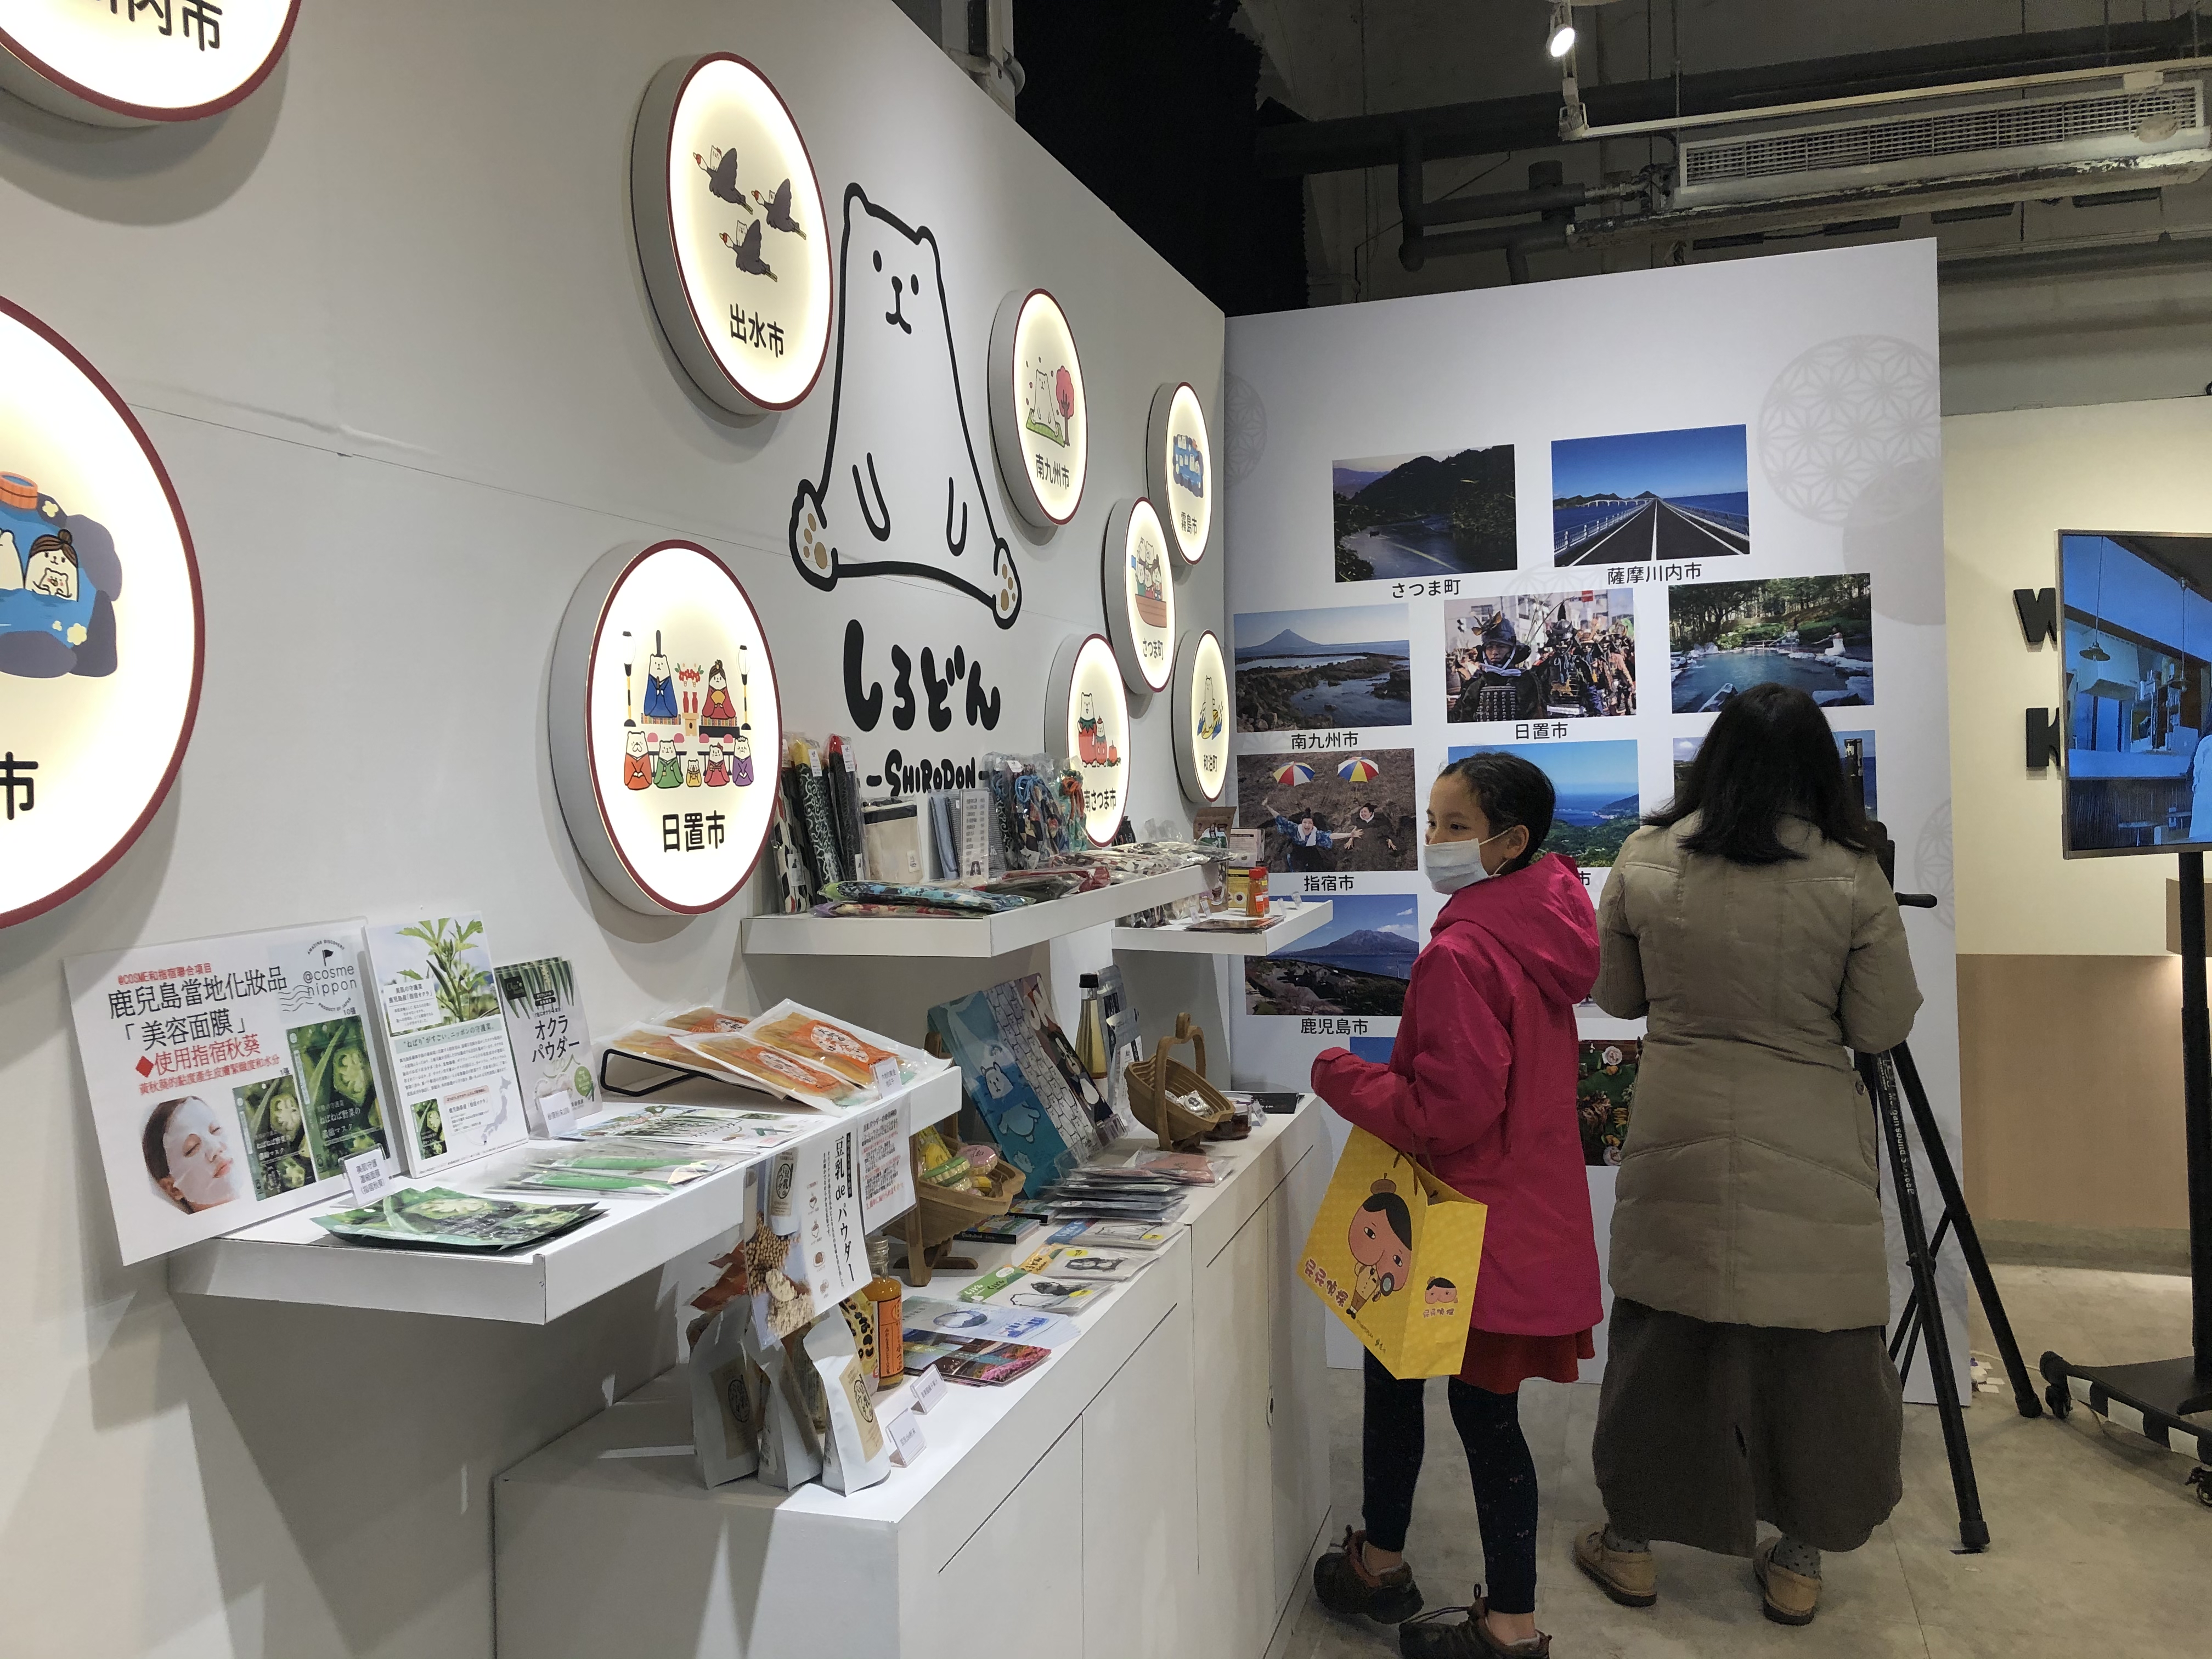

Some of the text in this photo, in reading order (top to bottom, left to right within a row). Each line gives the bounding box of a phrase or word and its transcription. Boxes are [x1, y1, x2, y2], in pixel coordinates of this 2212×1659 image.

[98, 0, 223, 51] 内市
[730, 303, 784, 358] 出水市
[1035, 453, 1070, 490] 南九州市
[1607, 562, 1703, 585] 薩摩川内市
[1391, 579, 1460, 599] さつま町
[1143, 637, 1164, 661] さつま町
[843, 619, 1001, 732] しろどん
[1291, 731, 1359, 751] 南九州市
[1515, 722, 1568, 741] 日置市
[1084, 787, 1116, 812] 南さつま市
[662, 809, 726, 853] 日置市
[1304, 875, 1355, 891] 指宿市
[303, 964, 354, 984] @cosme
[108, 966, 287, 1019] 鹿兒島當地化妝品
[308, 978, 357, 997] nippon
[535, 1015, 568, 1041] オクラ
[1300, 1018, 1369, 1035] 鹿児島市
[154, 1034, 261, 1076] 使用指宿秋葵
[532, 1035, 580, 1063] パウダー
